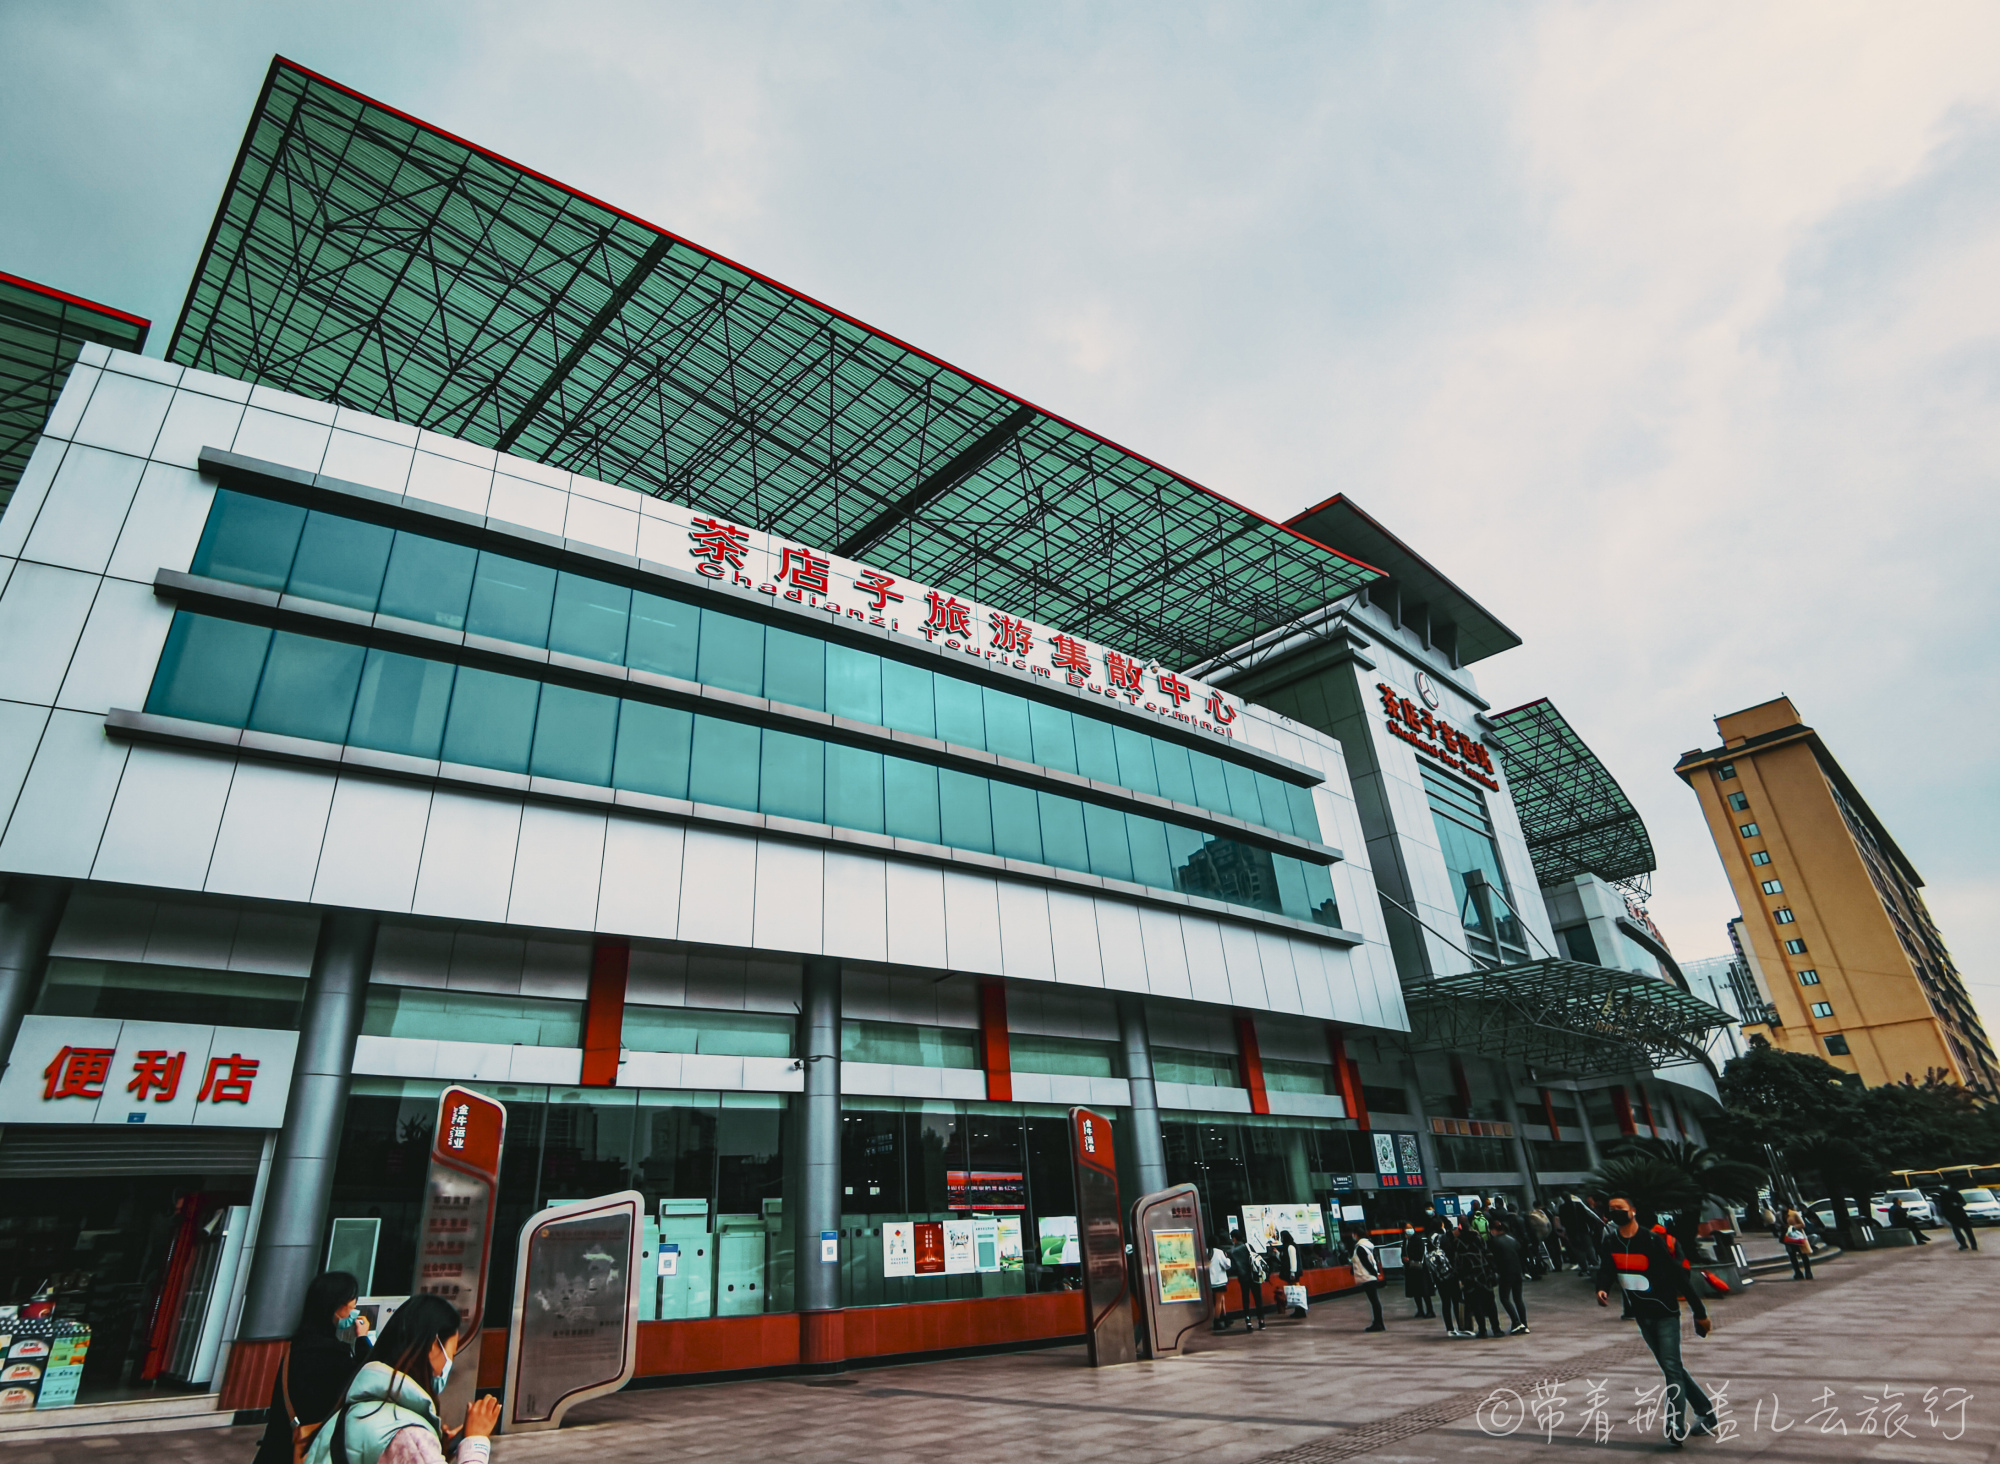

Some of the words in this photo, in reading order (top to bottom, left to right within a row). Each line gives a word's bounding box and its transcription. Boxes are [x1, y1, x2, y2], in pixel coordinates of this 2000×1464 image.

[689, 516, 1238, 725] 茶店子旅游集散中心
[696, 561, 899, 632] Chadianzi
[919, 626, 1051, 679] Tourism
[1376, 683, 1494, 775] 茶店子客运站
[43, 1045, 260, 1104] 便利店
[453, 1104, 470, 1149] 金牛运业
